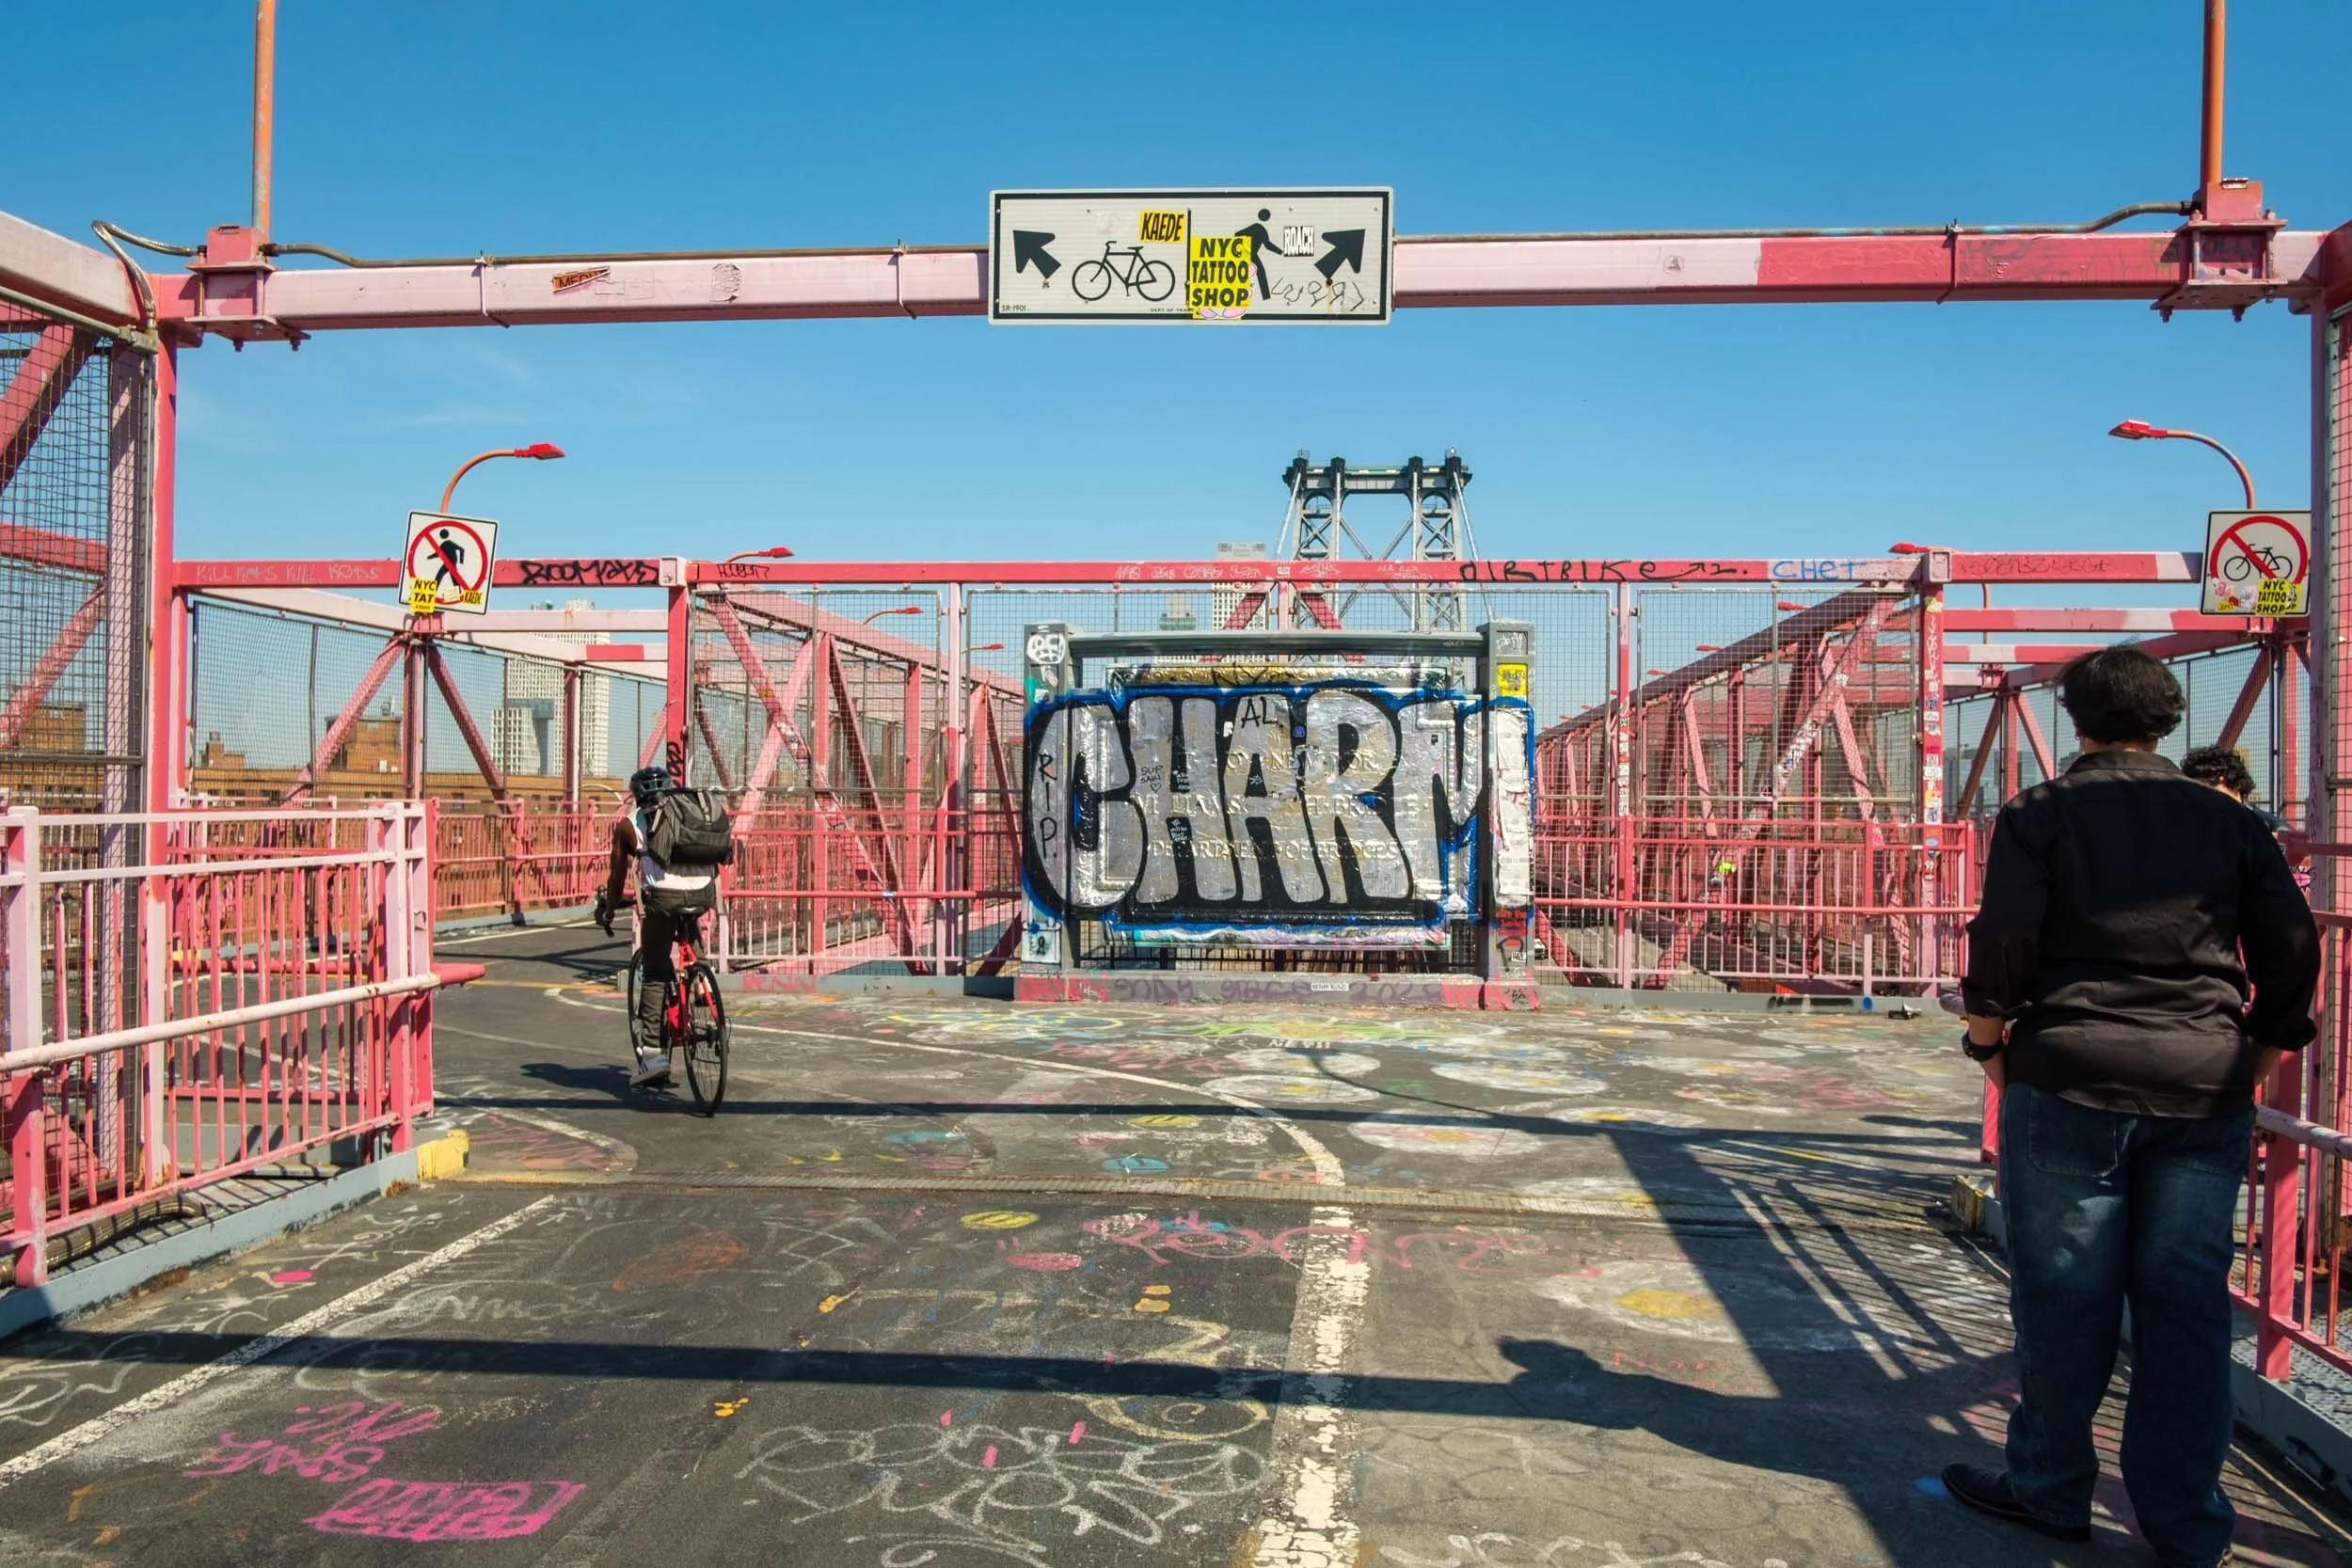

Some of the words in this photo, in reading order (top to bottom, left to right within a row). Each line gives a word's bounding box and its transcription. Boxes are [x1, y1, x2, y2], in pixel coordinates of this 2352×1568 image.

[1140, 213, 1184, 241] KAEDE
[1200, 238, 1244, 258] NYC
[1283, 226, 1314, 256] ROACH
[1191, 260, 1248, 283] TATTOO
[1191, 288, 1249, 308] SHOP
[413, 579, 437, 592] NYC
[2263, 580, 2286, 591] NYC
[413, 593, 435, 604] TAT
[2257, 591, 2287, 603] TATTOO
[2255, 603, 2285, 613] SHOP
